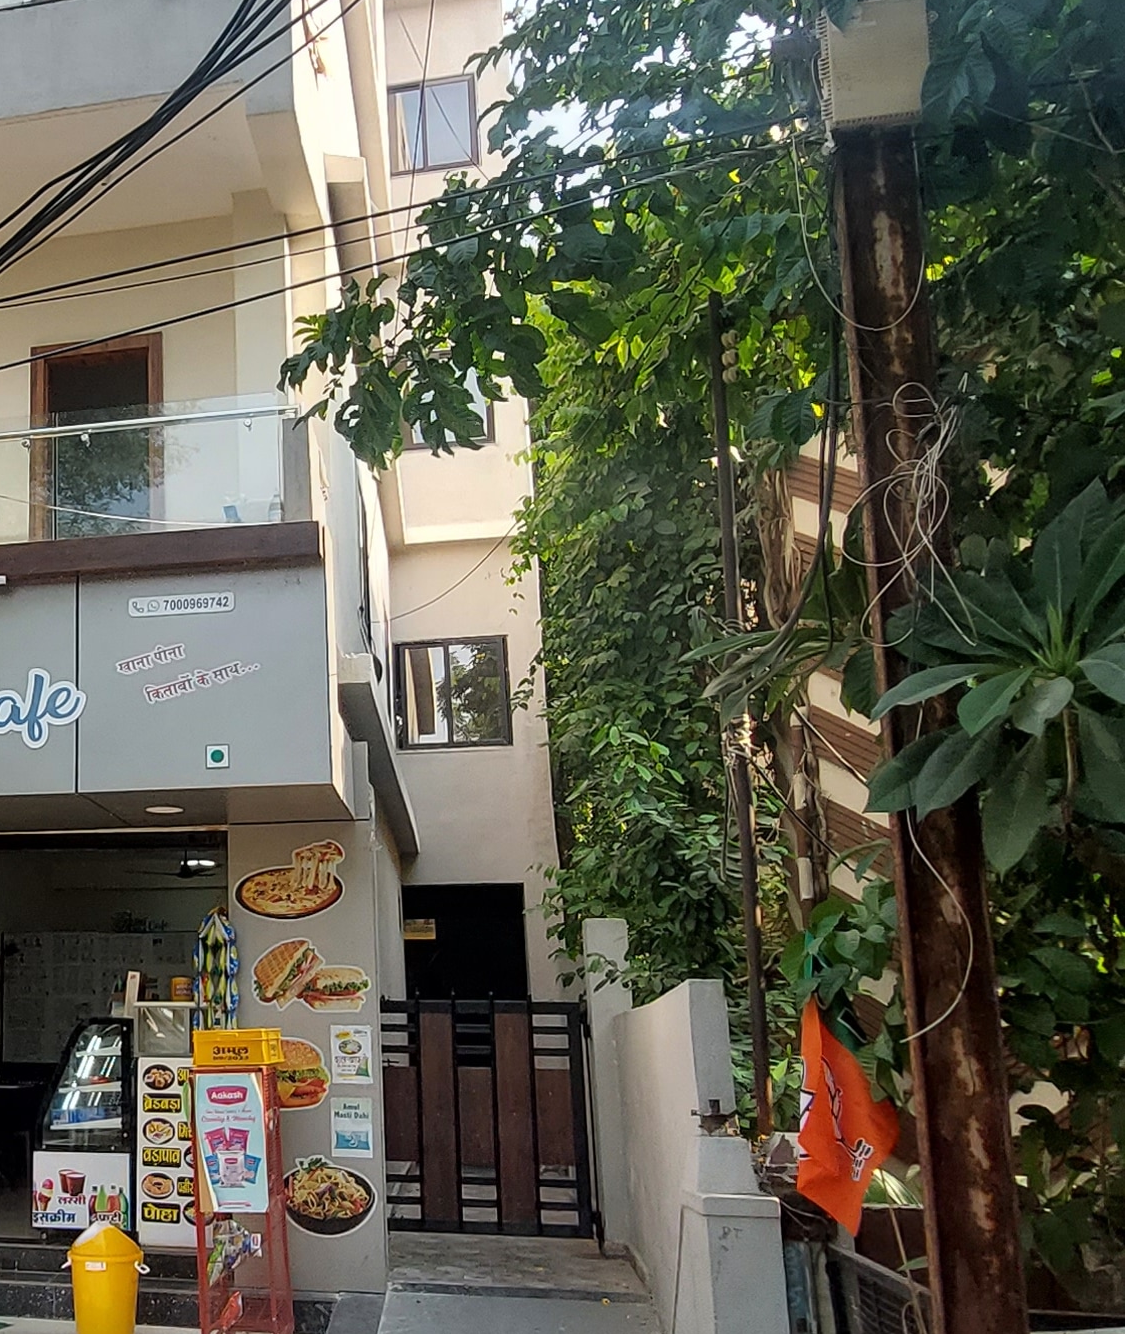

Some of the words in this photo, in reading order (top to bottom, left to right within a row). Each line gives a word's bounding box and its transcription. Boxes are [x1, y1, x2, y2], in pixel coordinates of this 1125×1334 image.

[163, 596, 229, 611] 7000969742
[118, 653, 153, 673] खाना
[154, 644, 185, 664] पीना
